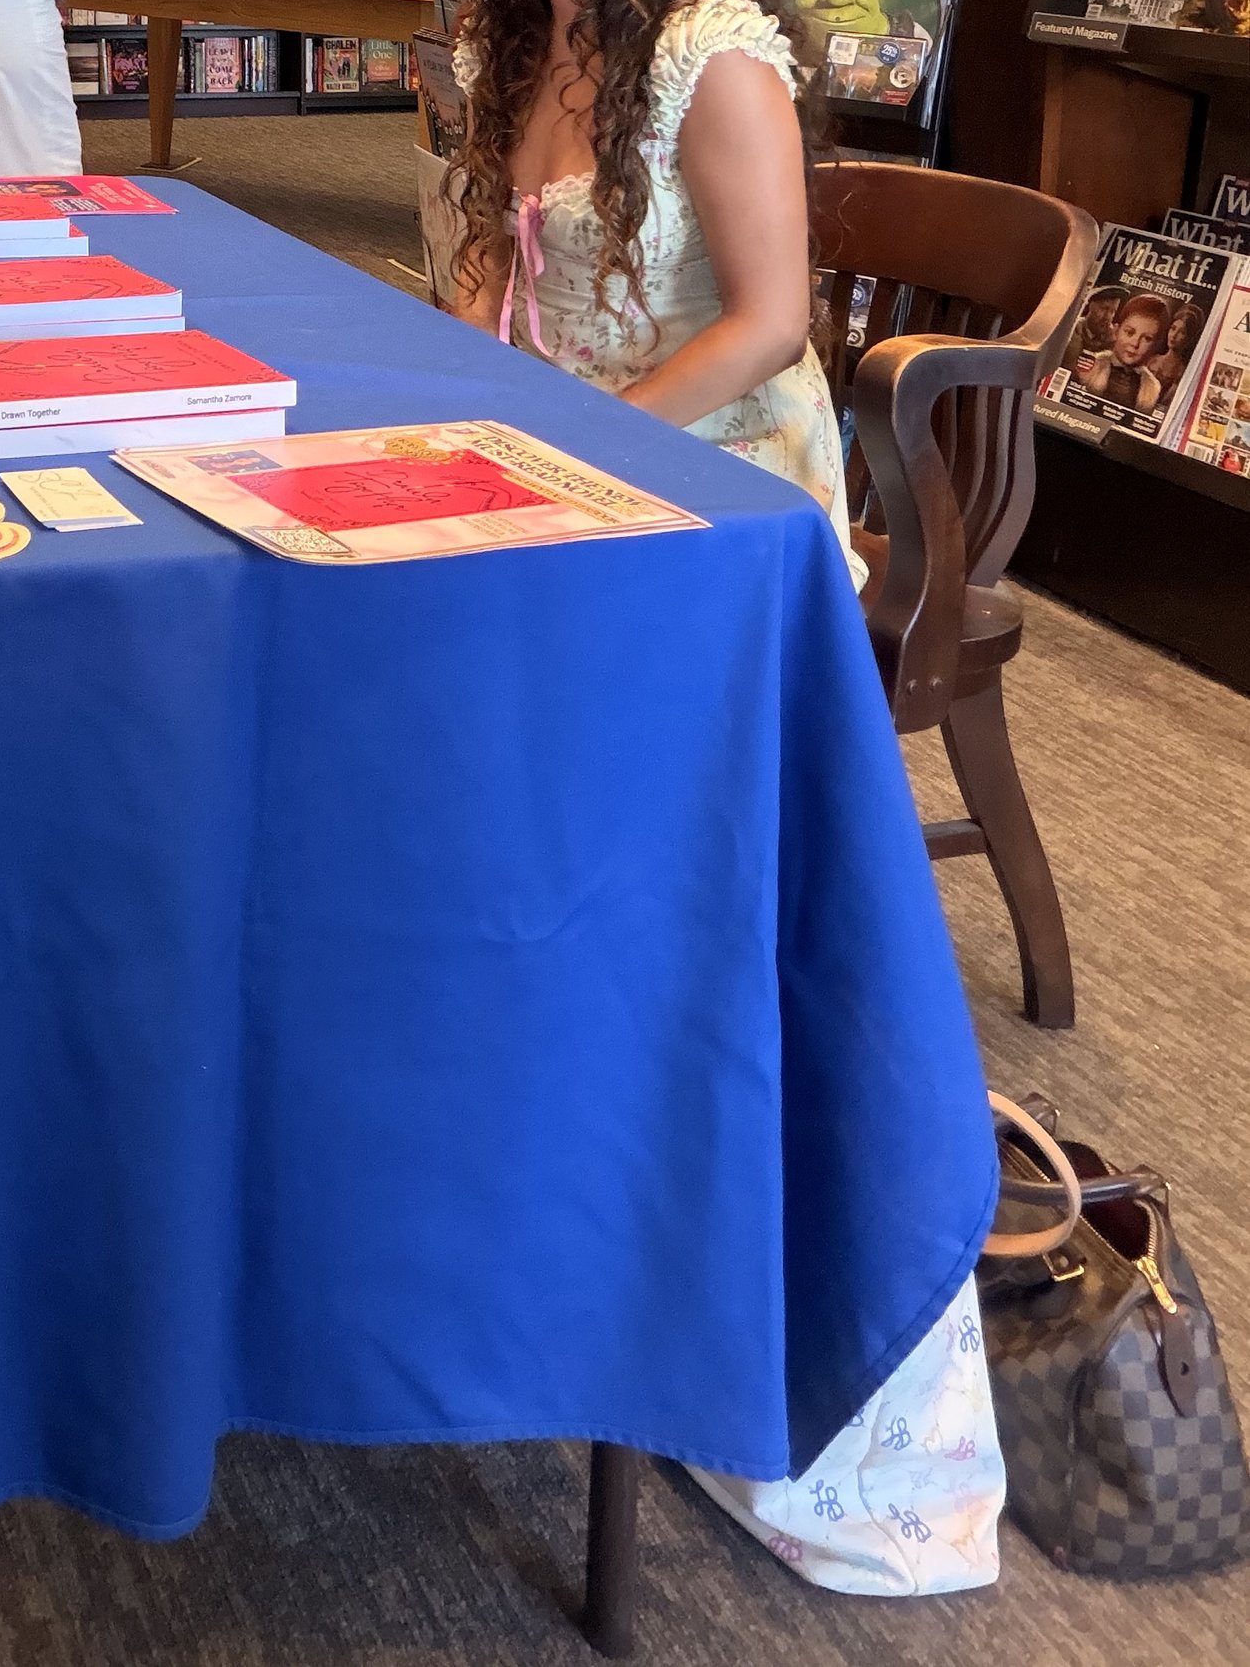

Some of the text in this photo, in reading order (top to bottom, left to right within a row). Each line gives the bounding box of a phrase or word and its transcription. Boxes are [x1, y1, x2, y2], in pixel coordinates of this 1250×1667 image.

[1034, 21, 1118, 41] Featured Magazine
[373, 51, 391, 59] One
[210, 77, 233, 85] BACK
[1114, 236, 1216, 290] What if...
[1119, 273, 1194, 303] British History
[187, 393, 252, 405] Samantha Zamora
[1, 407, 61, 420] Drawn Together
[1033, 404, 1058, 419] tured
[1058, 409, 1101, 434] Magazine
[483, 435, 567, 475] DISCOVER
[597, 486, 643, 507] NEW
[560, 479, 620, 508] NOVEL
